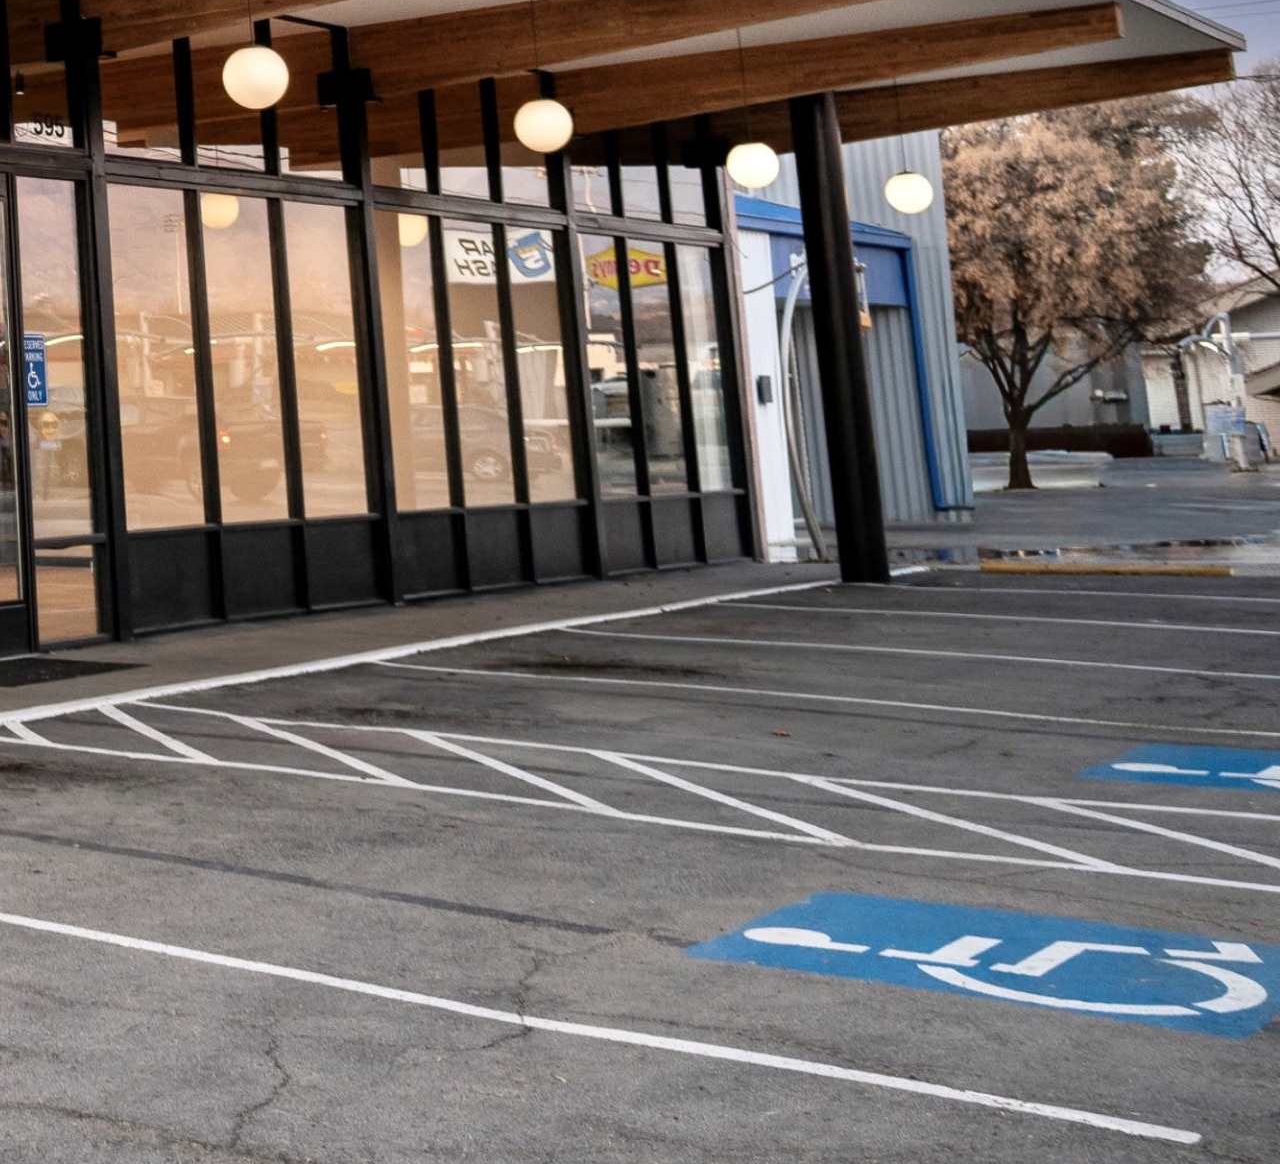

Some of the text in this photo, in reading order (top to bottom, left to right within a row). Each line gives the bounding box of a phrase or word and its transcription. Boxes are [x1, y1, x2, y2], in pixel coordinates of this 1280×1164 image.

[33, 114, 65, 137] 595
[24, 340, 43, 350] ESERVED
[25, 352, 43, 361] ARKING
